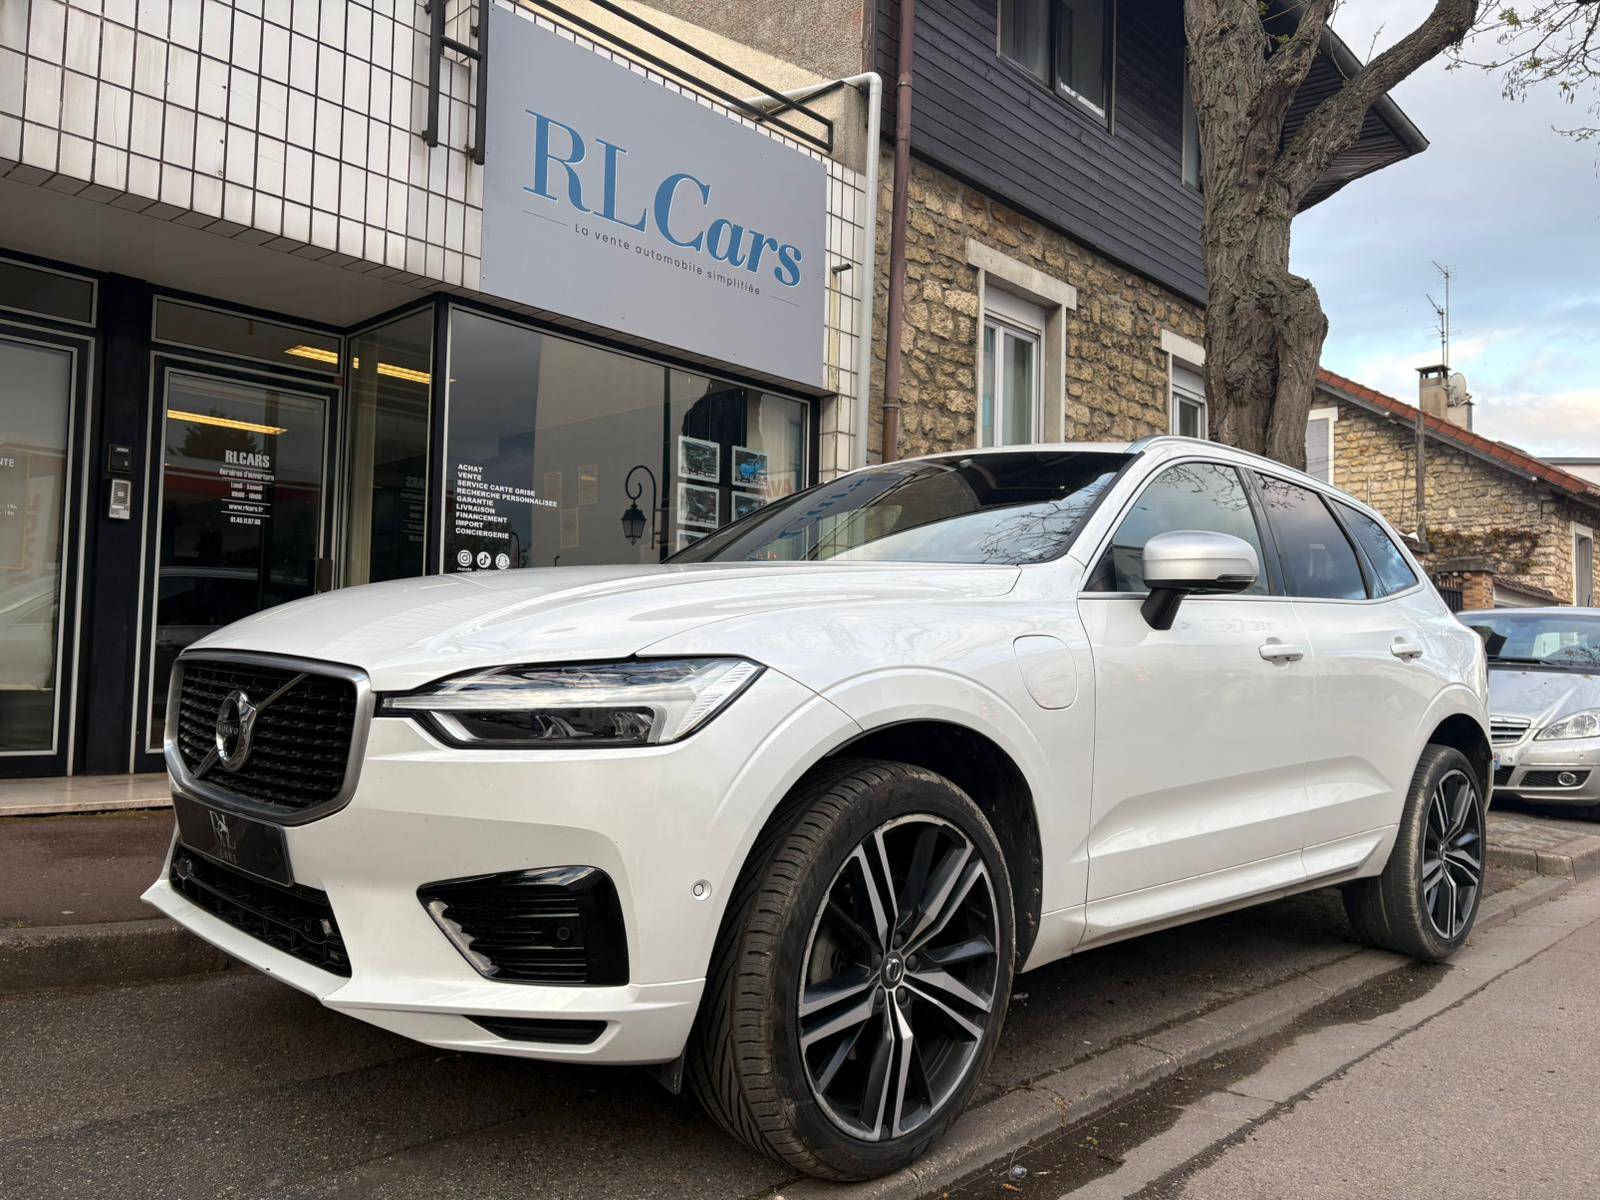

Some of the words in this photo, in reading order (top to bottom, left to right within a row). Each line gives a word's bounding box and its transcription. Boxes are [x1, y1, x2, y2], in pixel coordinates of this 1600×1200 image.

[523, 109, 802, 287] RLCars
[575, 223, 589, 236] La
[595, 232, 630, 250] vente
[635, 246, 703, 275] automobile
[707, 270, 761, 296] simplifiée
[225, 450, 270, 468] RLCARS
[457, 464, 483, 473] ACHAT
[457, 471, 482, 481] VENTE
[456, 487, 501, 500] RECHERCHE
[457, 479, 489, 489] SERVICE
[489, 484, 513, 494] CARTE
[514, 488, 536, 497] GRISE
[456, 495, 494, 506] GARANTIE
[228, 503, 264, 513] www.rlcars.fr
[456, 503, 496, 514] LIVRAISON
[455, 511, 508, 523] FINANCEMENT
[455, 519, 484, 528] IMPORT
[455, 527, 510, 539] CONCIERGERIE
